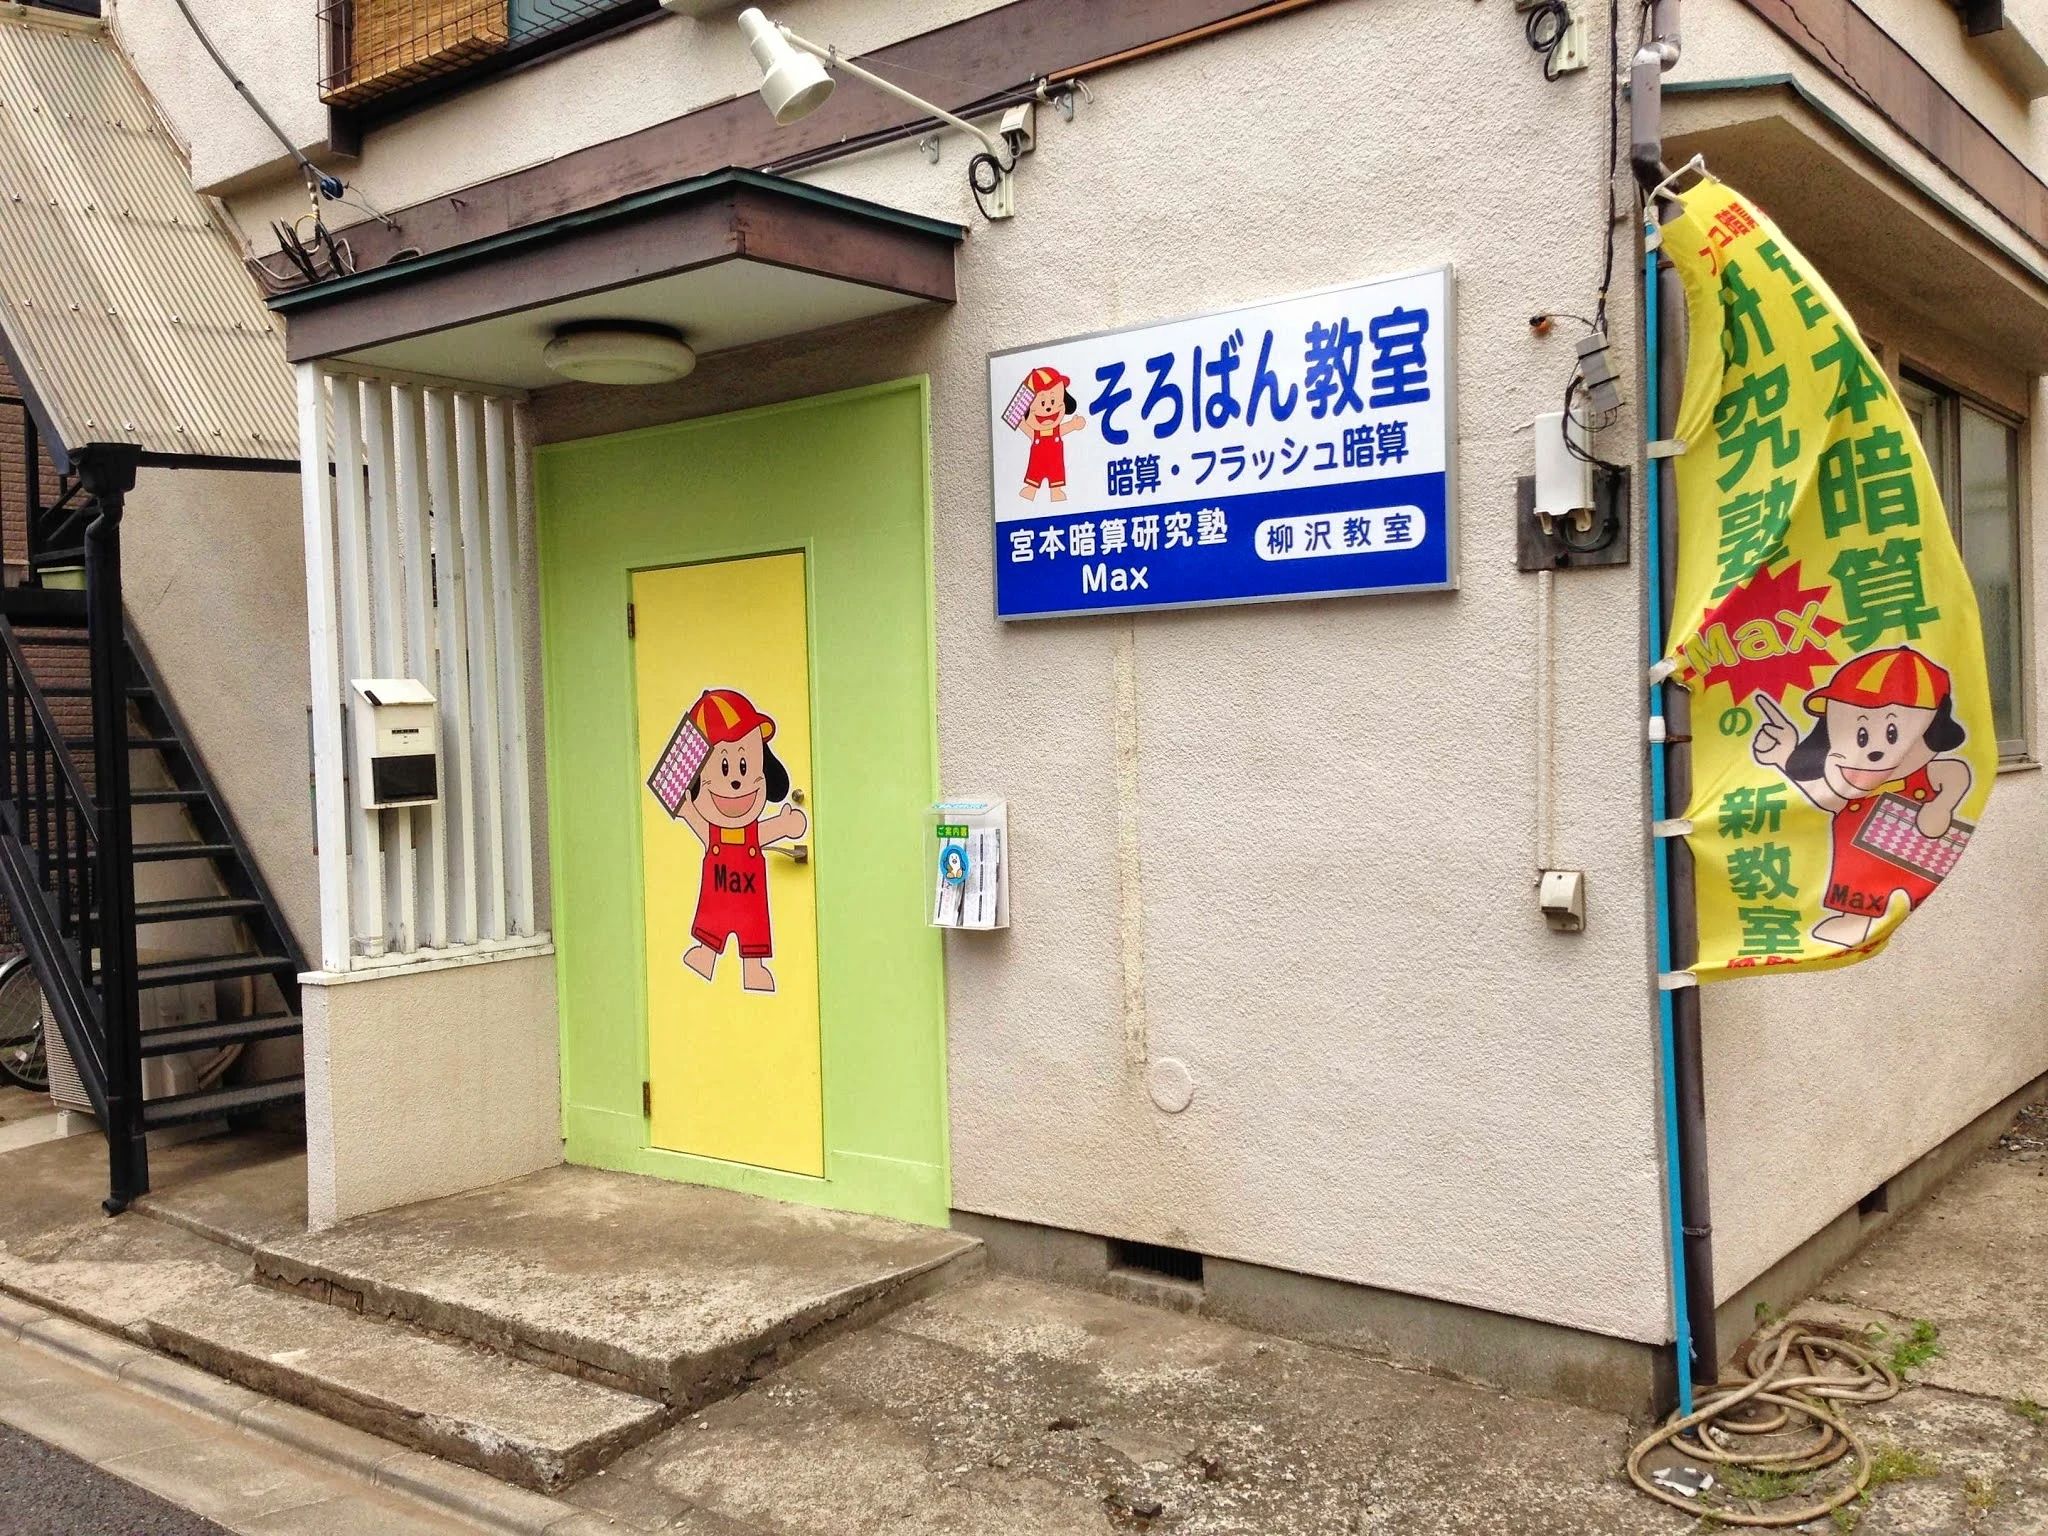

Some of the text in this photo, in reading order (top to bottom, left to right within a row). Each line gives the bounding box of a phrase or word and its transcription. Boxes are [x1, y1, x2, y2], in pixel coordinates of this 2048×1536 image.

[1088, 305, 1432, 446] そろばん教室
[1107, 420, 1409, 497] 暗算・フラッシュ暗算
[1010, 507, 1228, 563] 宮本暗算研究塾
[1266, 512, 1414, 555] 柳沢教室
[1082, 562, 1149, 594] Max
[1685, 600, 1828, 677] Max
[714, 863, 756, 893] Max
[1830, 883, 1886, 912] Max
